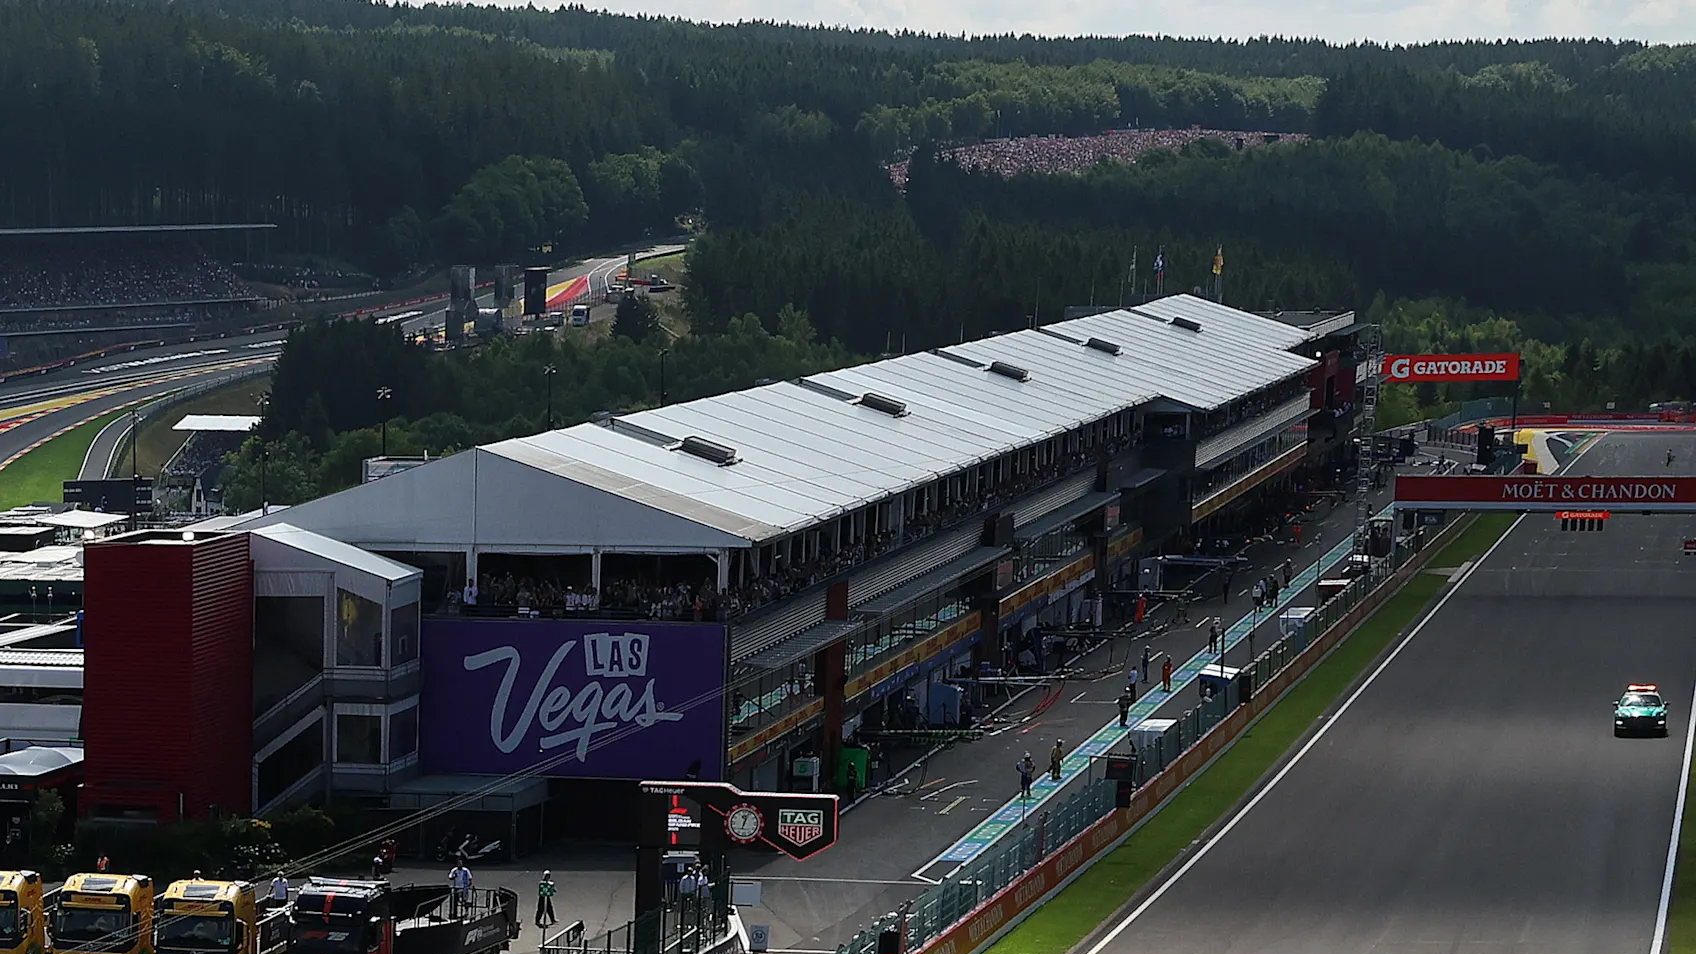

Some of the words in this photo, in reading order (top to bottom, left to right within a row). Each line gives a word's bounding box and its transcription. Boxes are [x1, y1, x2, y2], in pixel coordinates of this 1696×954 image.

[1414, 360, 1507, 375] GATORADE
[1502, 481, 1558, 499] MOËT
[1562, 486, 1575, 498] &
[1578, 484, 1676, 499] CHANDON
[586, 635, 647, 675] LAS
[464, 640, 684, 762] Vegas
[782, 812, 818, 824] TAG
[781, 826, 820, 844] HEUER
